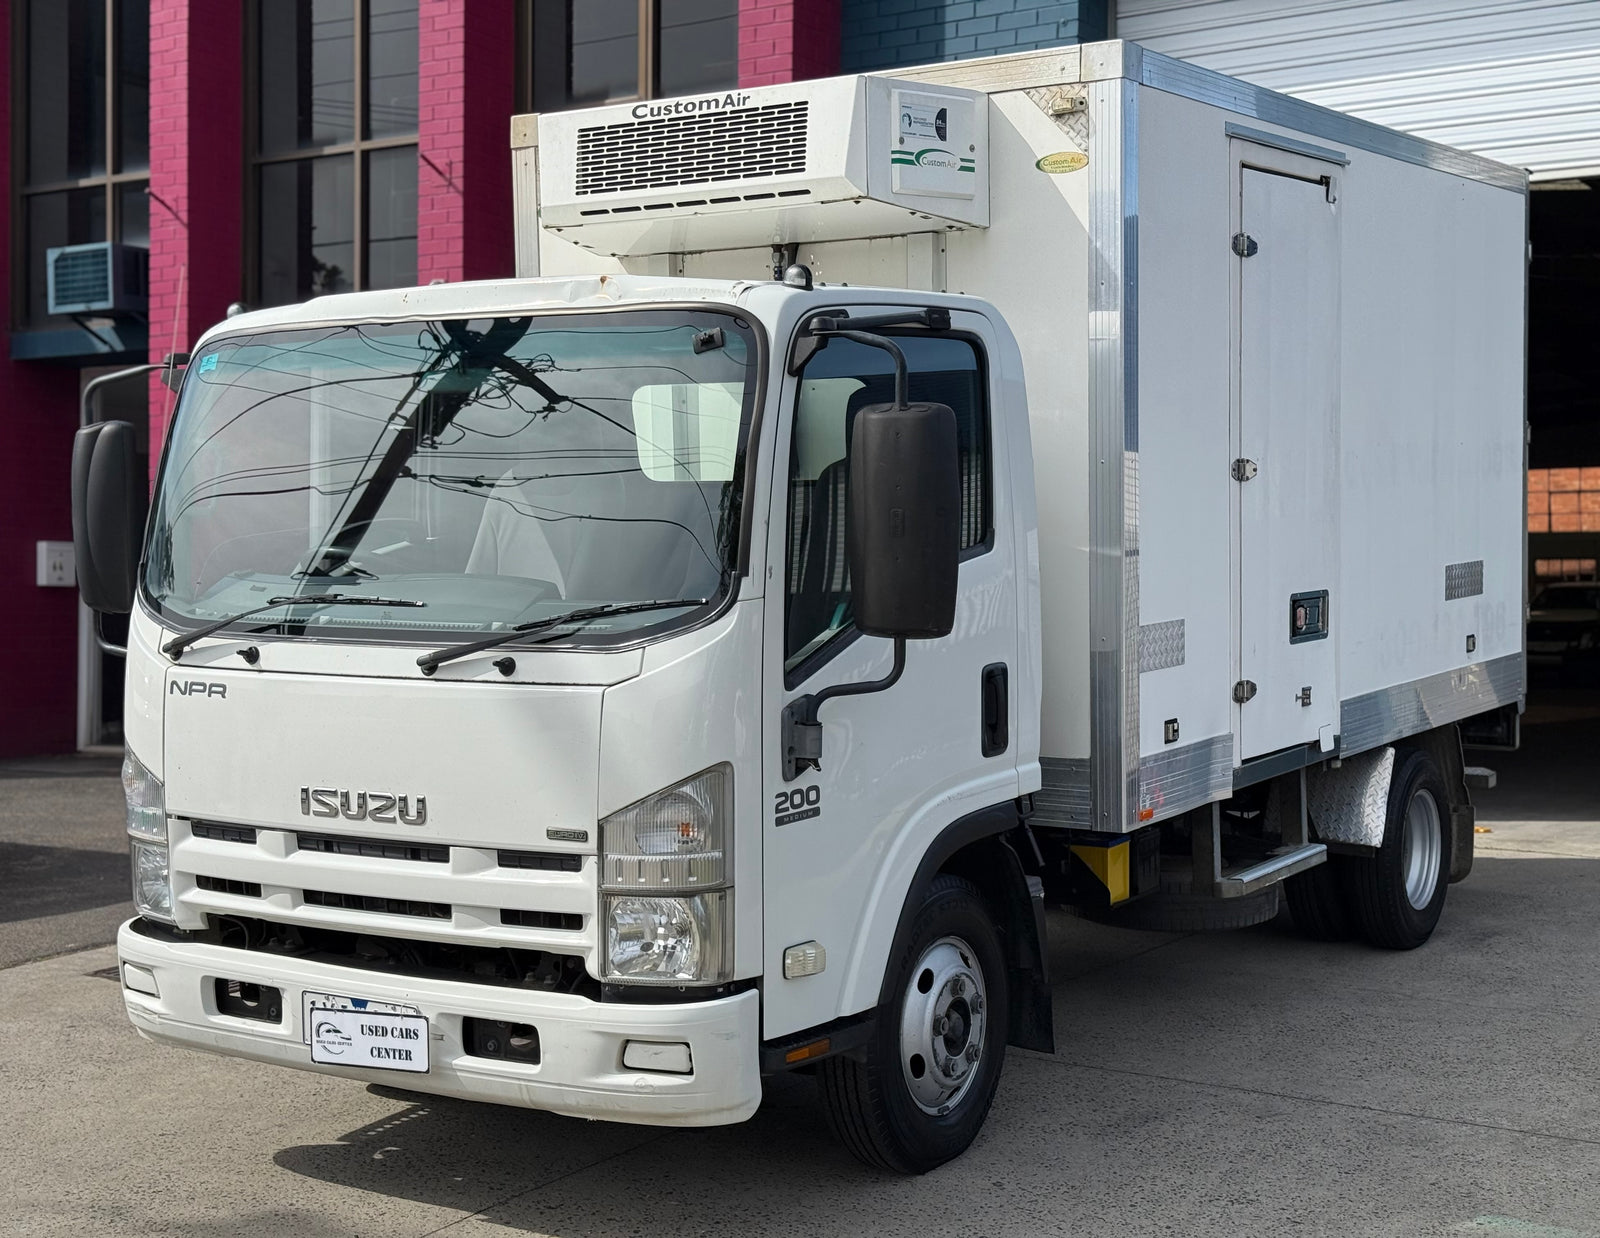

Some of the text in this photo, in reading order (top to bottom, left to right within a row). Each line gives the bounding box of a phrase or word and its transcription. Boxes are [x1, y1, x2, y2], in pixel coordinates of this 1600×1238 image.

[632, 93, 751, 119] CustomAir
[169, 680, 227, 699] NPR
[301, 785, 427, 826] ISUZU
[775, 785, 821, 814] 200
[783, 810, 814, 823] MEDIUM
[360, 1024, 419, 1040] USED CARS
[370, 1046, 413, 1062] CENTER
